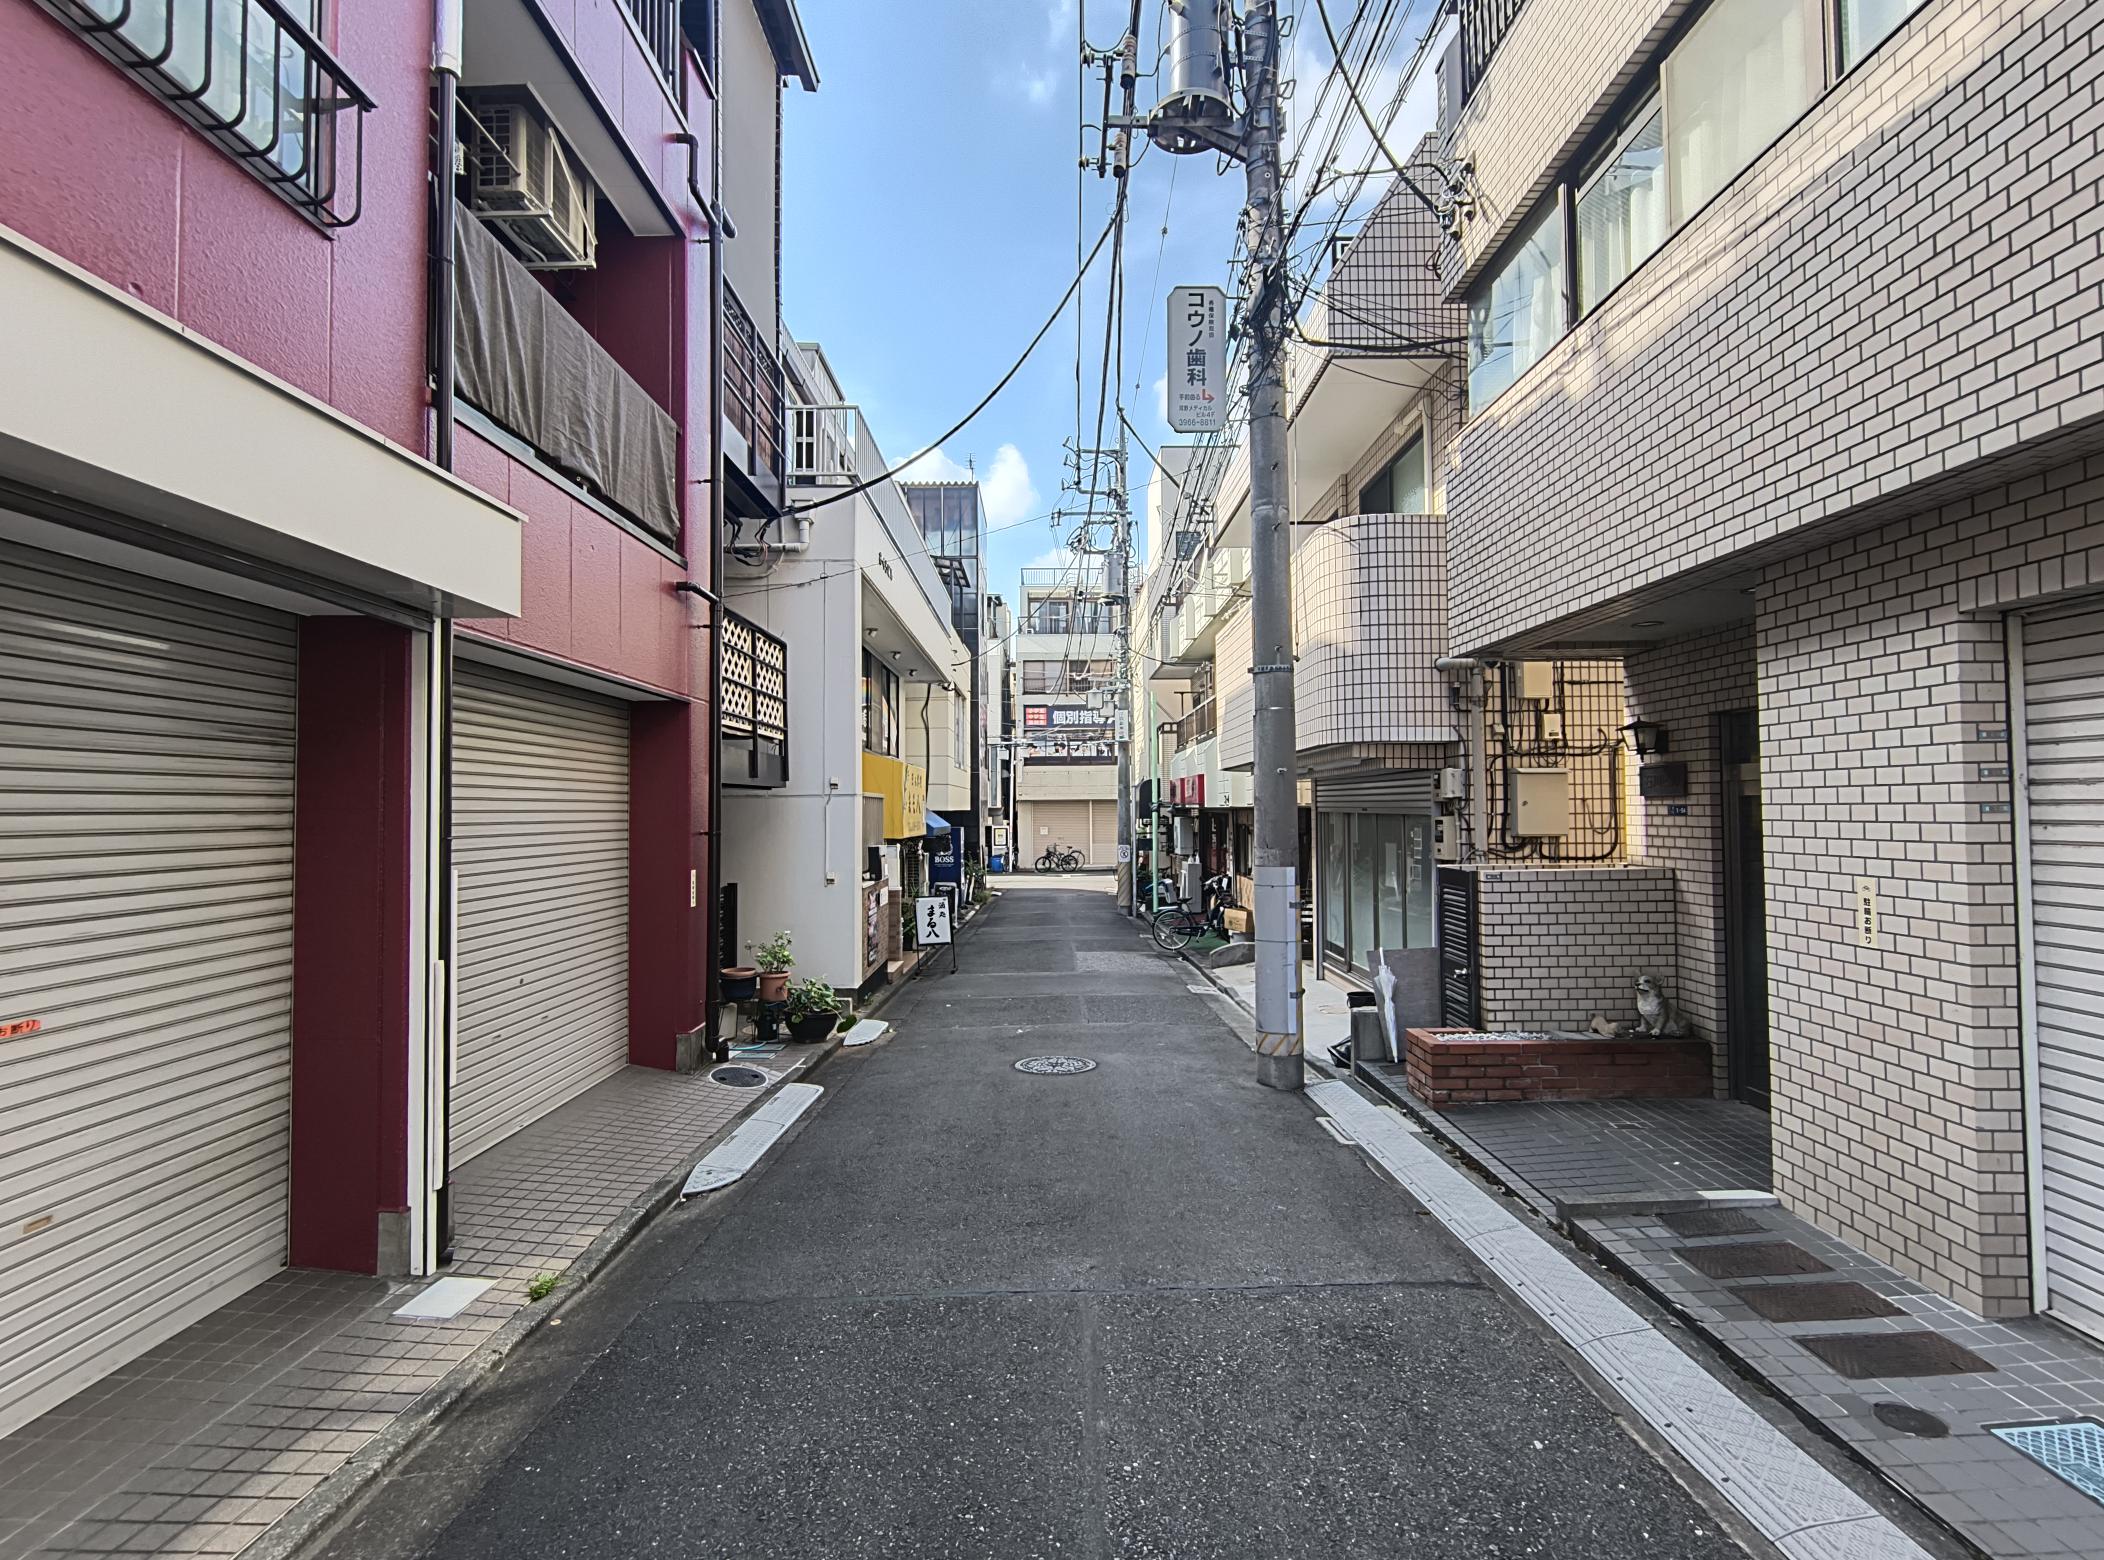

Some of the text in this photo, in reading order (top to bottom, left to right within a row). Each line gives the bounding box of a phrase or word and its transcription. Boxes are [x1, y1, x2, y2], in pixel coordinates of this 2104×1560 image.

[1187, 292, 1206, 387] コウノ歯科
[934, 855, 954, 863] BOSS
[926, 904, 940, 938] まる八
